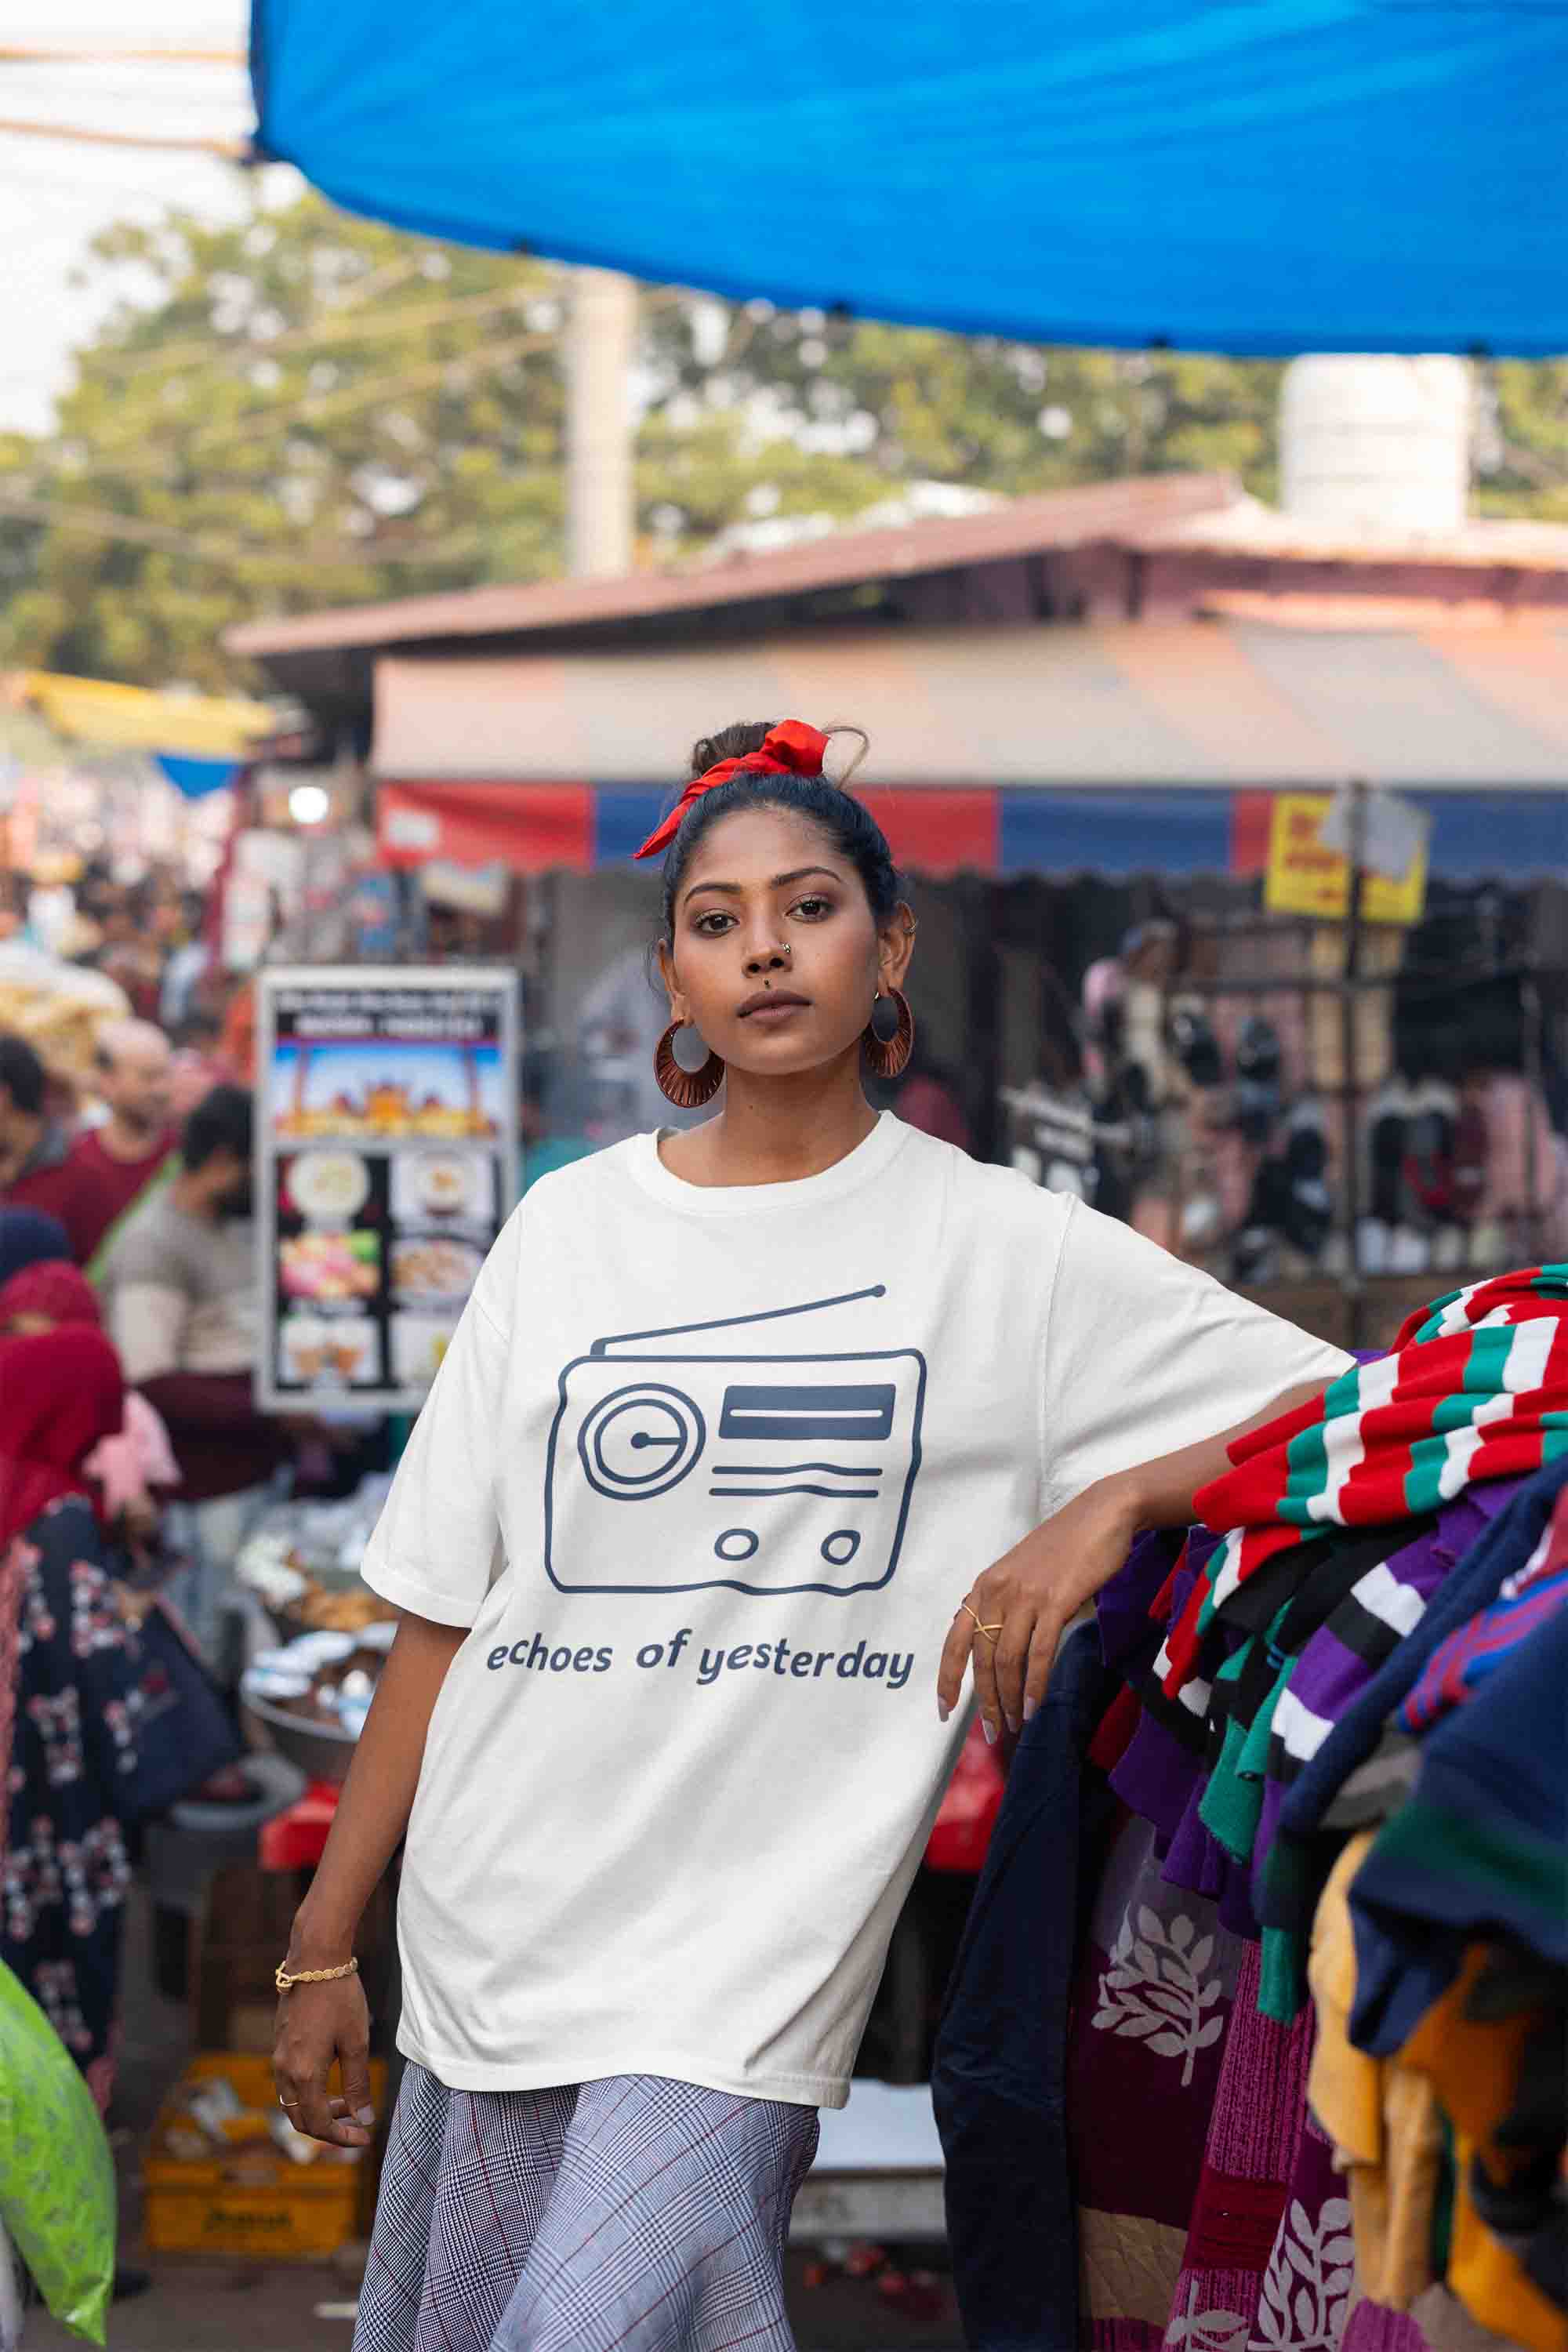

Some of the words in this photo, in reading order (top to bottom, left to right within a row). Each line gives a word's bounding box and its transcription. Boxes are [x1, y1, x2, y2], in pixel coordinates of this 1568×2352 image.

[487, 1632, 614, 1672] echoes
[637, 1628, 693, 1668] of
[695, 1638, 915, 1690] yesterday
